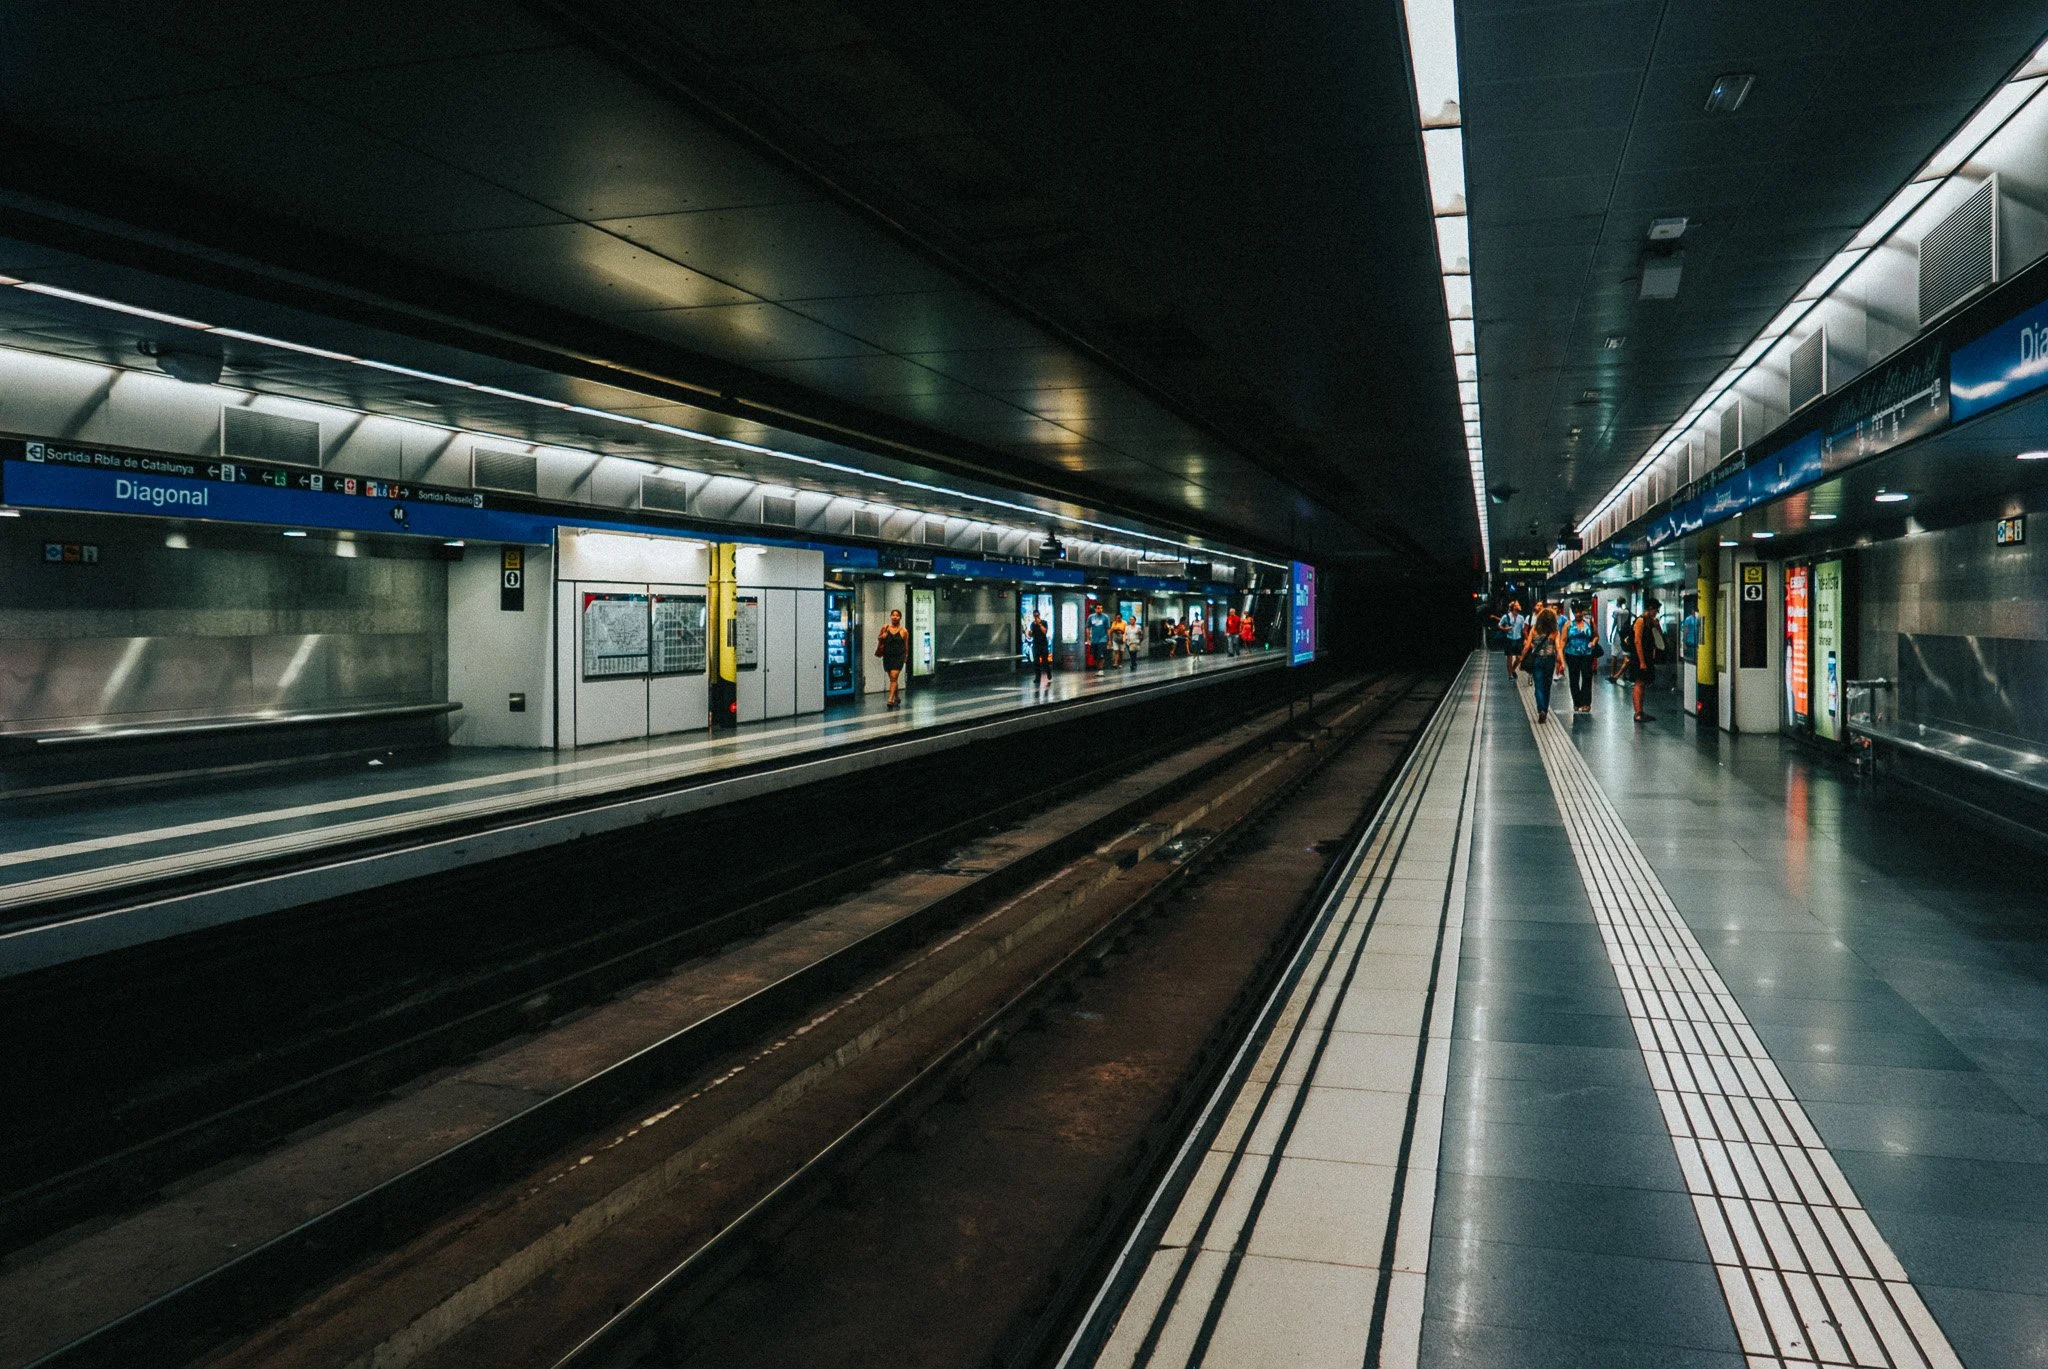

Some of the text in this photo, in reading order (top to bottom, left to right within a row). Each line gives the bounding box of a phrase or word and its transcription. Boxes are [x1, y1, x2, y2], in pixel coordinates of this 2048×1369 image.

[46, 448, 195, 476] Sortida Rbla de Catalunya
[115, 479, 208, 507] Diagonal
[418, 490, 444, 502] Sortida
[393, 508, 403, 520] M
